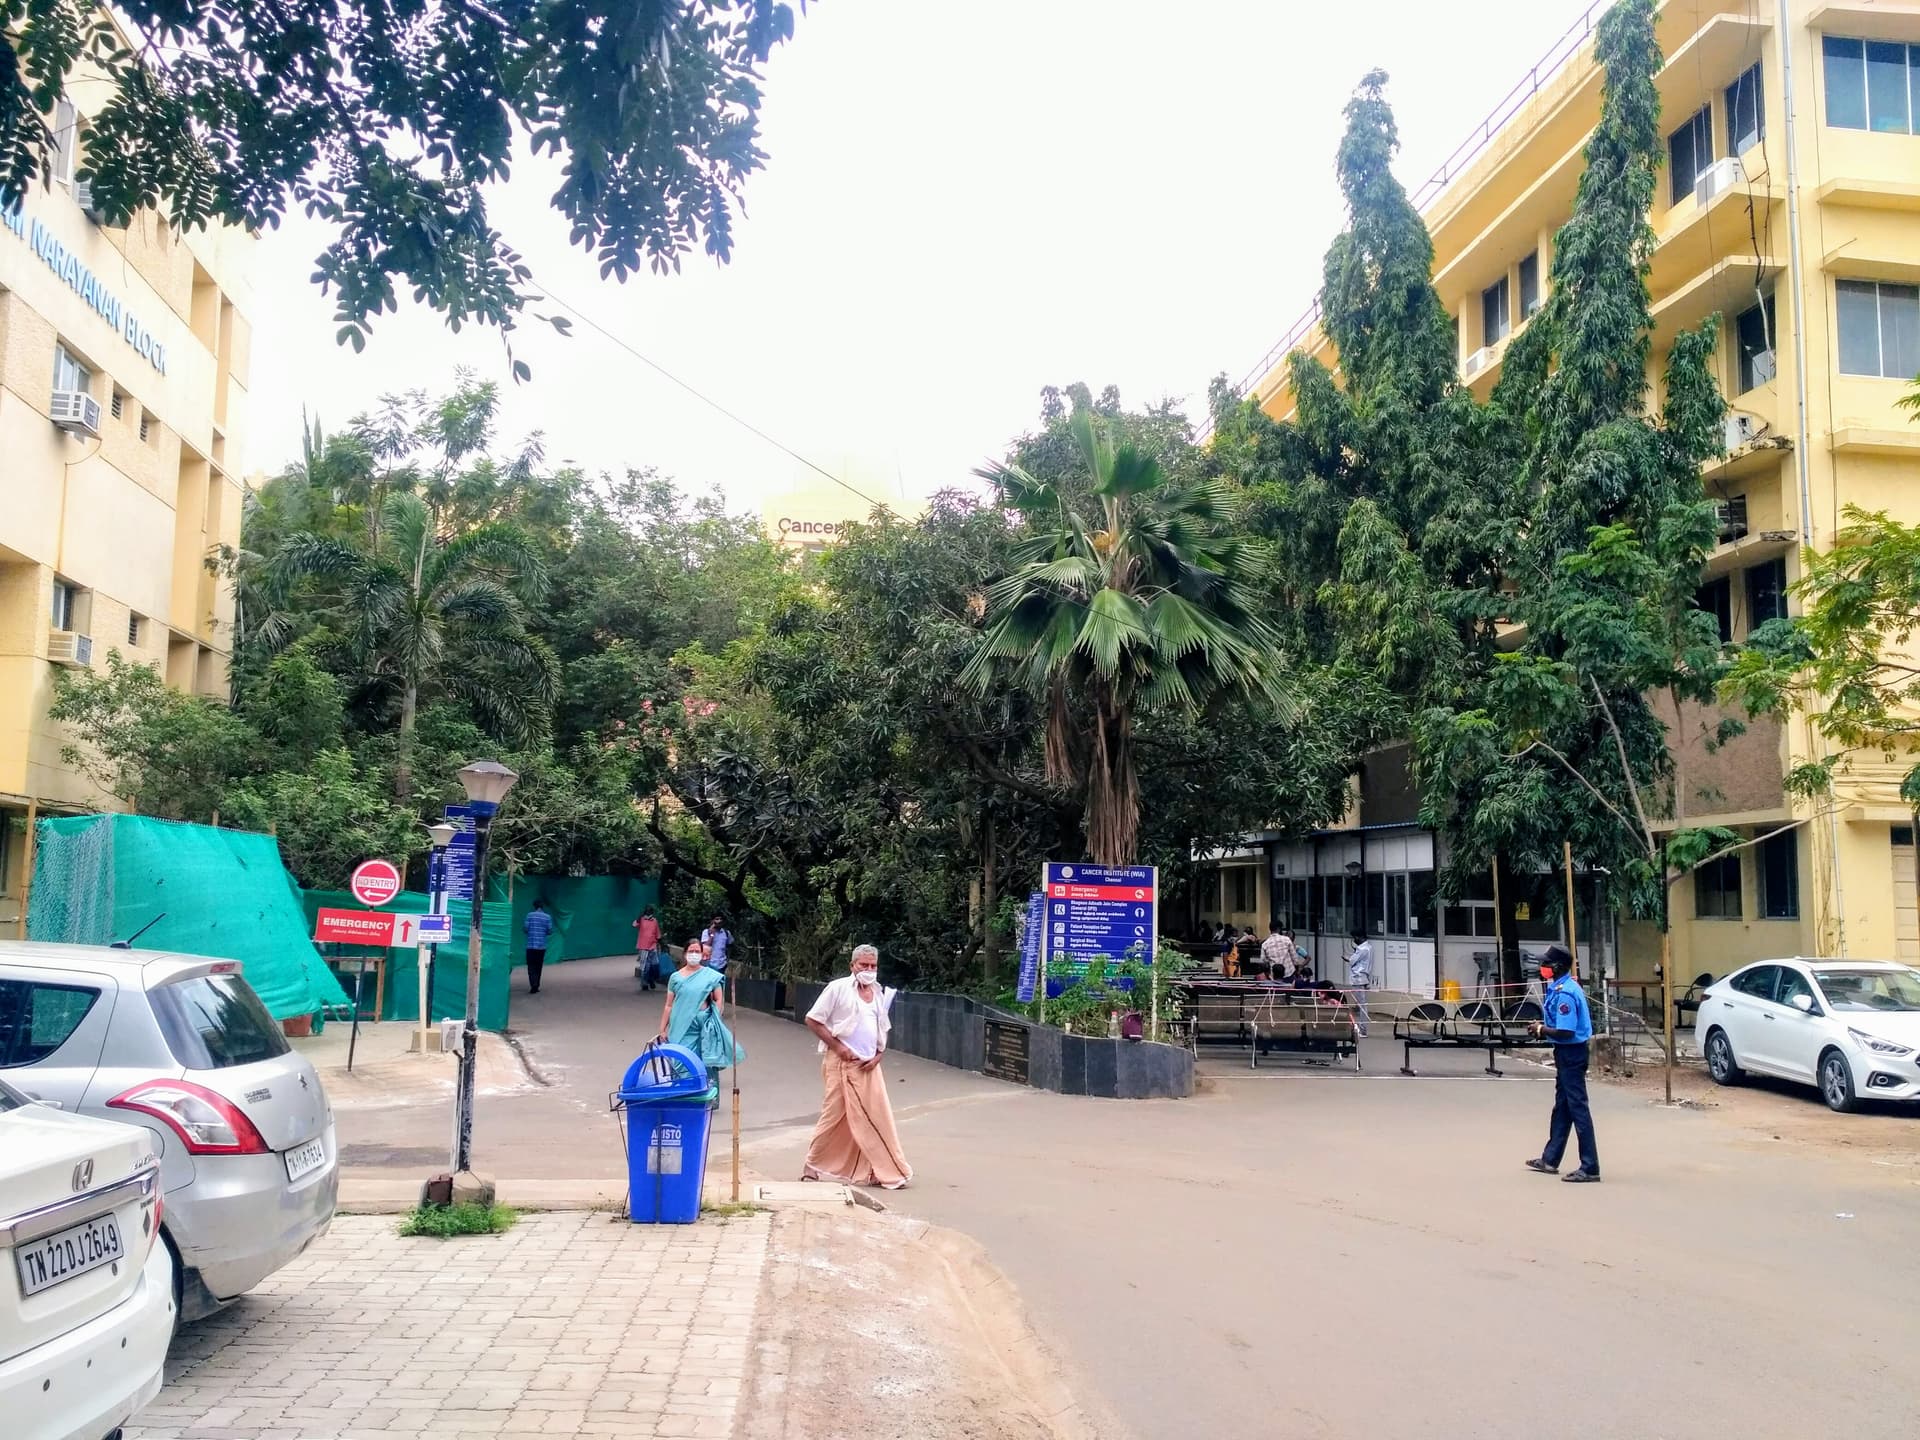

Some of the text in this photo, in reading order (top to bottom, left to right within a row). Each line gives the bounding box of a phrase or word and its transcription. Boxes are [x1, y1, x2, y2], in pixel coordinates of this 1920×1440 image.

[31, 217, 121, 332] NARAYANAN
[125, 312, 168, 376] BLOCK
[778, 518, 842, 534] Cancer
[358, 878, 394, 888] NO ENTRY
[323, 917, 391, 931] EMERGENCY
[651, 1129, 681, 1139] AISTO
